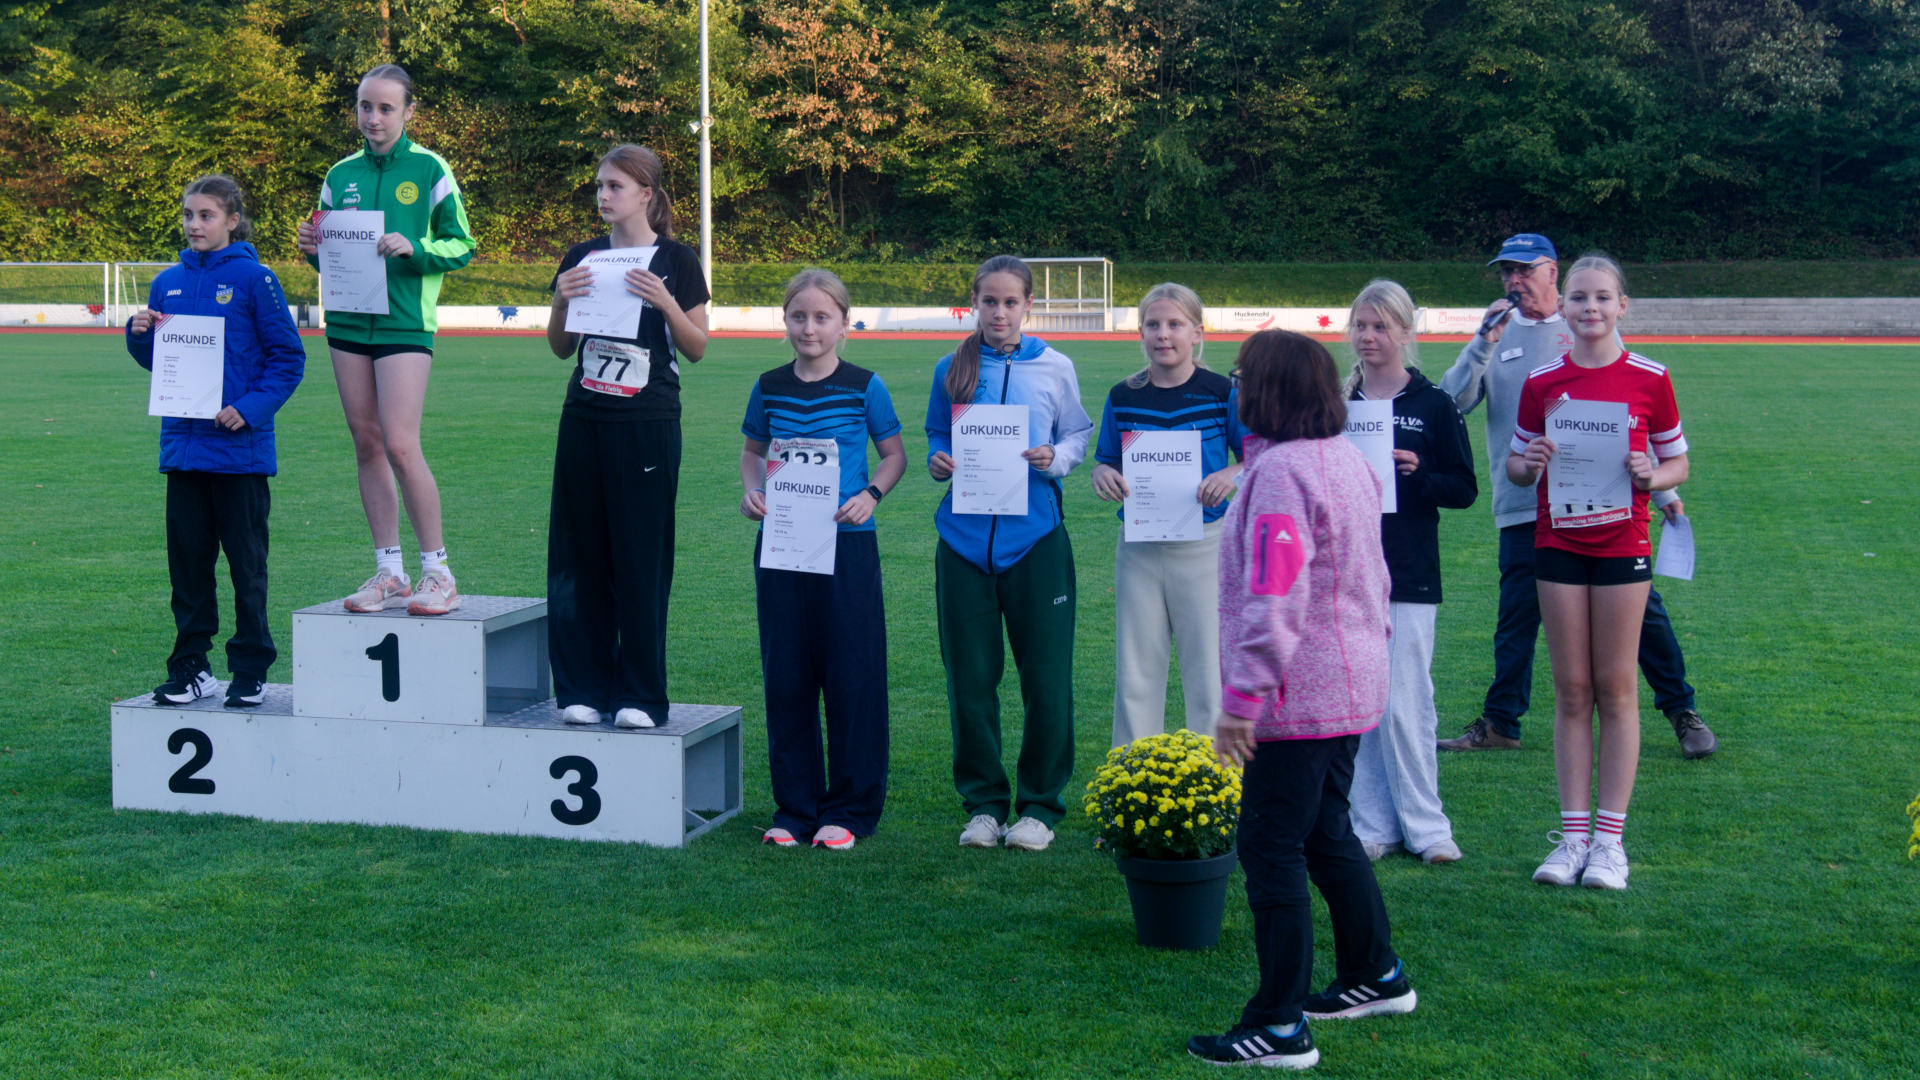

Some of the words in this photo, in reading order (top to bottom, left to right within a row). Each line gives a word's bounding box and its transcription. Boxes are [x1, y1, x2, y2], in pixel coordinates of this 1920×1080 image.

[322, 229, 376, 241] URKUNDE
[588, 256, 644, 264] URKUNDE
[162, 333, 216, 345] URKUNDE
[597, 354, 631, 382] 77
[960, 425, 1020, 436] URKUNDE
[1344, 421, 1384, 432] KUNDE
[1555, 418, 1619, 434] URKUNDE
[1131, 452, 1192, 463] URKUNDE
[774, 481, 831, 496] URKUNDE
[365, 632, 400, 702] 1
[167, 727, 216, 795] 2
[549, 755, 602, 826] 3
